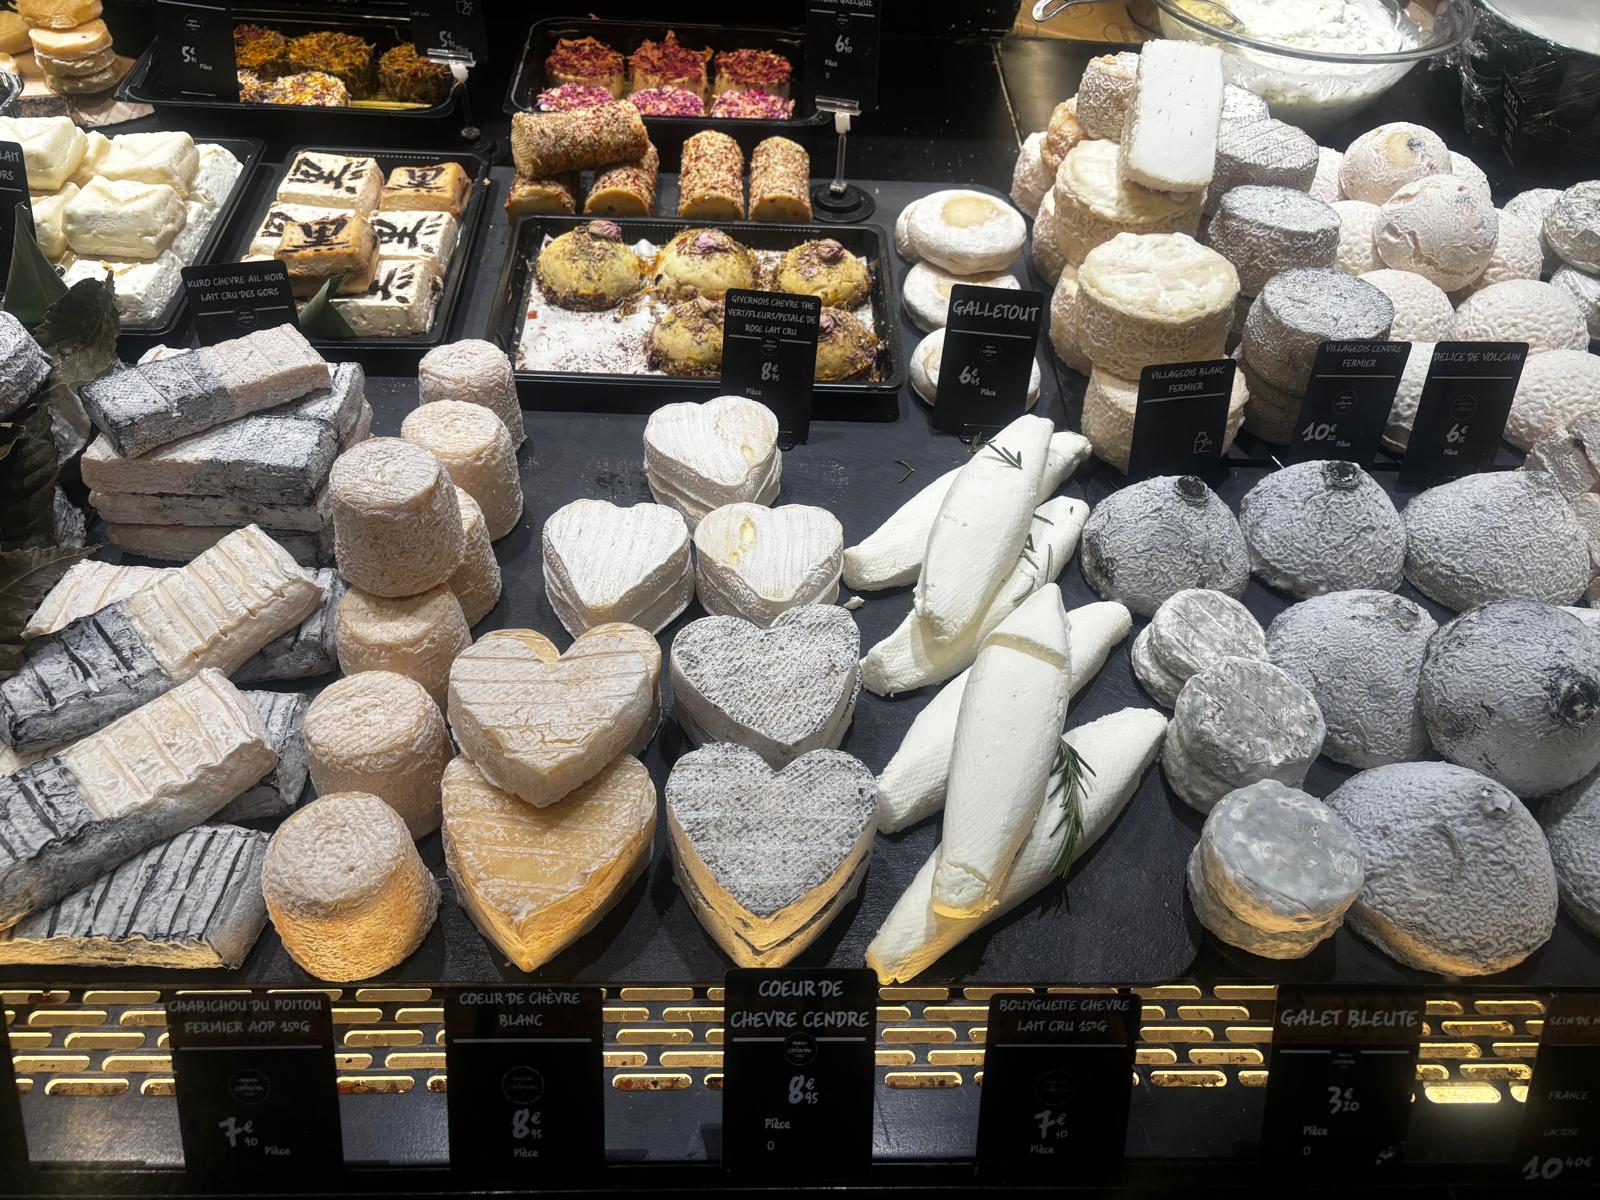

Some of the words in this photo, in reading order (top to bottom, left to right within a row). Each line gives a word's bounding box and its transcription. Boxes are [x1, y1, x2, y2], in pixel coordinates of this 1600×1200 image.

[187, 279, 211, 289] KURO
[213, 275, 246, 287] CHEVRE
[248, 273, 262, 284] AIL
[264, 272, 286, 282] NOIR
[201, 292, 219, 302] LAIT
[221, 291, 238, 300] CRU
[238, 290, 256, 299] DES
[257, 287, 279, 298] GORS
[770, 298, 799, 309] CHEVRE
[801, 301, 816, 311] THE
[952, 299, 1040, 322] GALLETOUT
[744, 324, 763, 333] ROSE
[765, 326, 782, 335] LAIT
[783, 327, 798, 336] CRU
[1326, 344, 1371, 353] VILLAGEOIS
[1371, 344, 1402, 353] CENDRE
[1341, 359, 1377, 368] FERMIER
[1433, 352, 1466, 362] DELICE
[1466, 352, 1481, 362] DE
[1482, 352, 1522, 362] VOLCAIN
[1151, 369, 1197, 381] VILLAGEOIS
[1199, 366, 1226, 377] BLANC
[1168, 382, 1204, 393] FERMIER
[759, 979, 817, 998] COEUR
[817, 980, 845, 997] DE
[459, 991, 504, 1006] COEUR
[506, 992, 528, 1005] DE
[1079, 999, 1130, 1011] CHEVRE
[169, 999, 251, 1014] CHABICHOU
[251, 1000, 272, 1012] DU
[274, 999, 322, 1012] POITOU
[498, 1013, 545, 1029] BLANC
[730, 1010, 798, 1029] CHEVRE
[802, 1010, 871, 1028] CENDRE
[1280, 1008, 1343, 1029] GALET
[1345, 1009, 1419, 1029] BLEUTE
[184, 1020, 244, 1034] FERMIER
[248, 1020, 276, 1032] AOP
[1017, 1020, 1047, 1033] LAIT
[1049, 1020, 1075, 1032] CRU
[1548, 1089, 1590, 1102] FRANCE
[764, 1116, 792, 1130] Pièce
[264, 1144, 292, 1157] Pièce
[513, 1147, 541, 1159] Pièce
